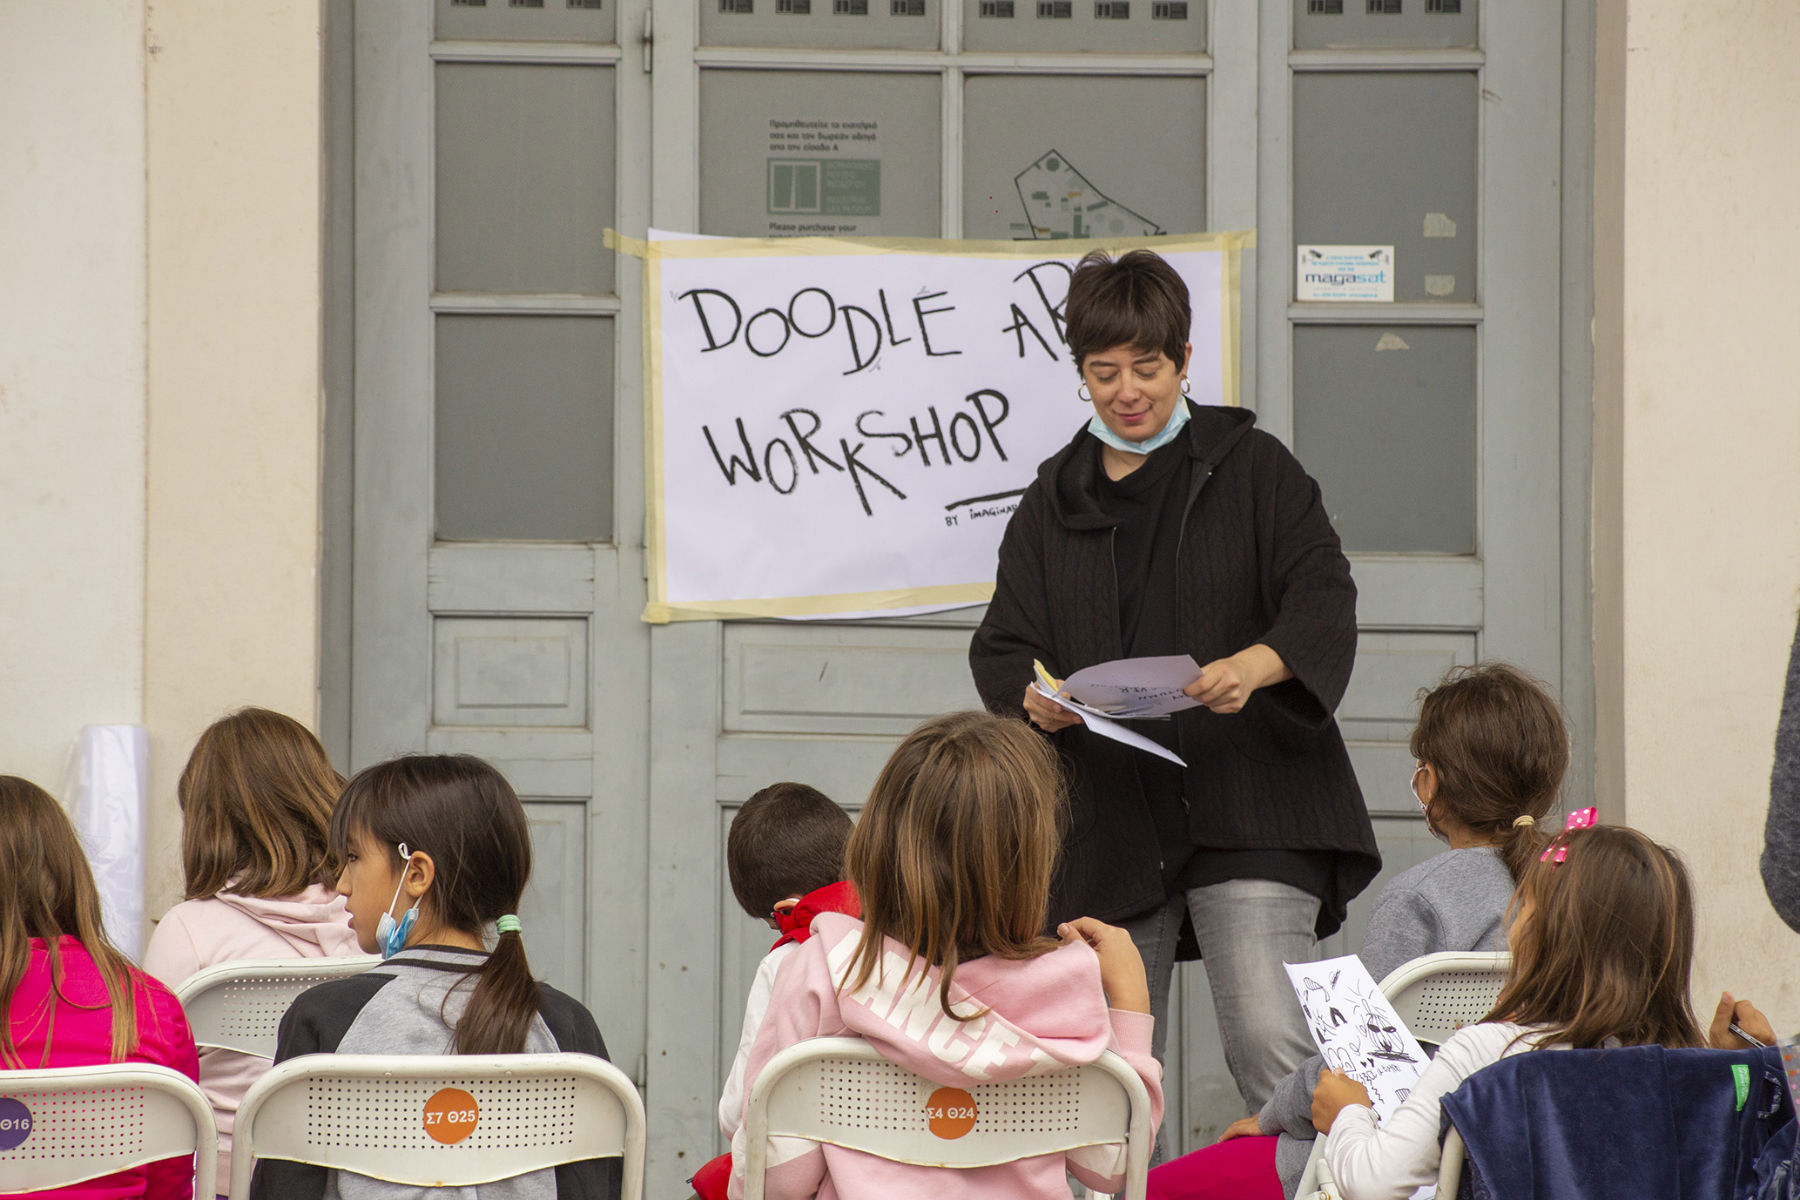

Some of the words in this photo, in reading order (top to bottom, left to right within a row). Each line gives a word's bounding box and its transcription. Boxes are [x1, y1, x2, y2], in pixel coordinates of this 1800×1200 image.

[769, 221, 796, 232] Please
[798, 222, 836, 233] purchase
[838, 224, 857, 233] your
[1304, 270, 1387, 286] magasat
[677, 287, 963, 376] DOODLE
[702, 388, 1010, 517] WORKSHOP
[944, 514, 959, 527] BY
[426, 1111, 443, 1125] Σ7
[447, 1109, 476, 1124] Θ25
[926, 1106, 944, 1120] Σ4
[947, 1106, 975, 1120] Θ24
[0, 1117, 30, 1131] Θ16
